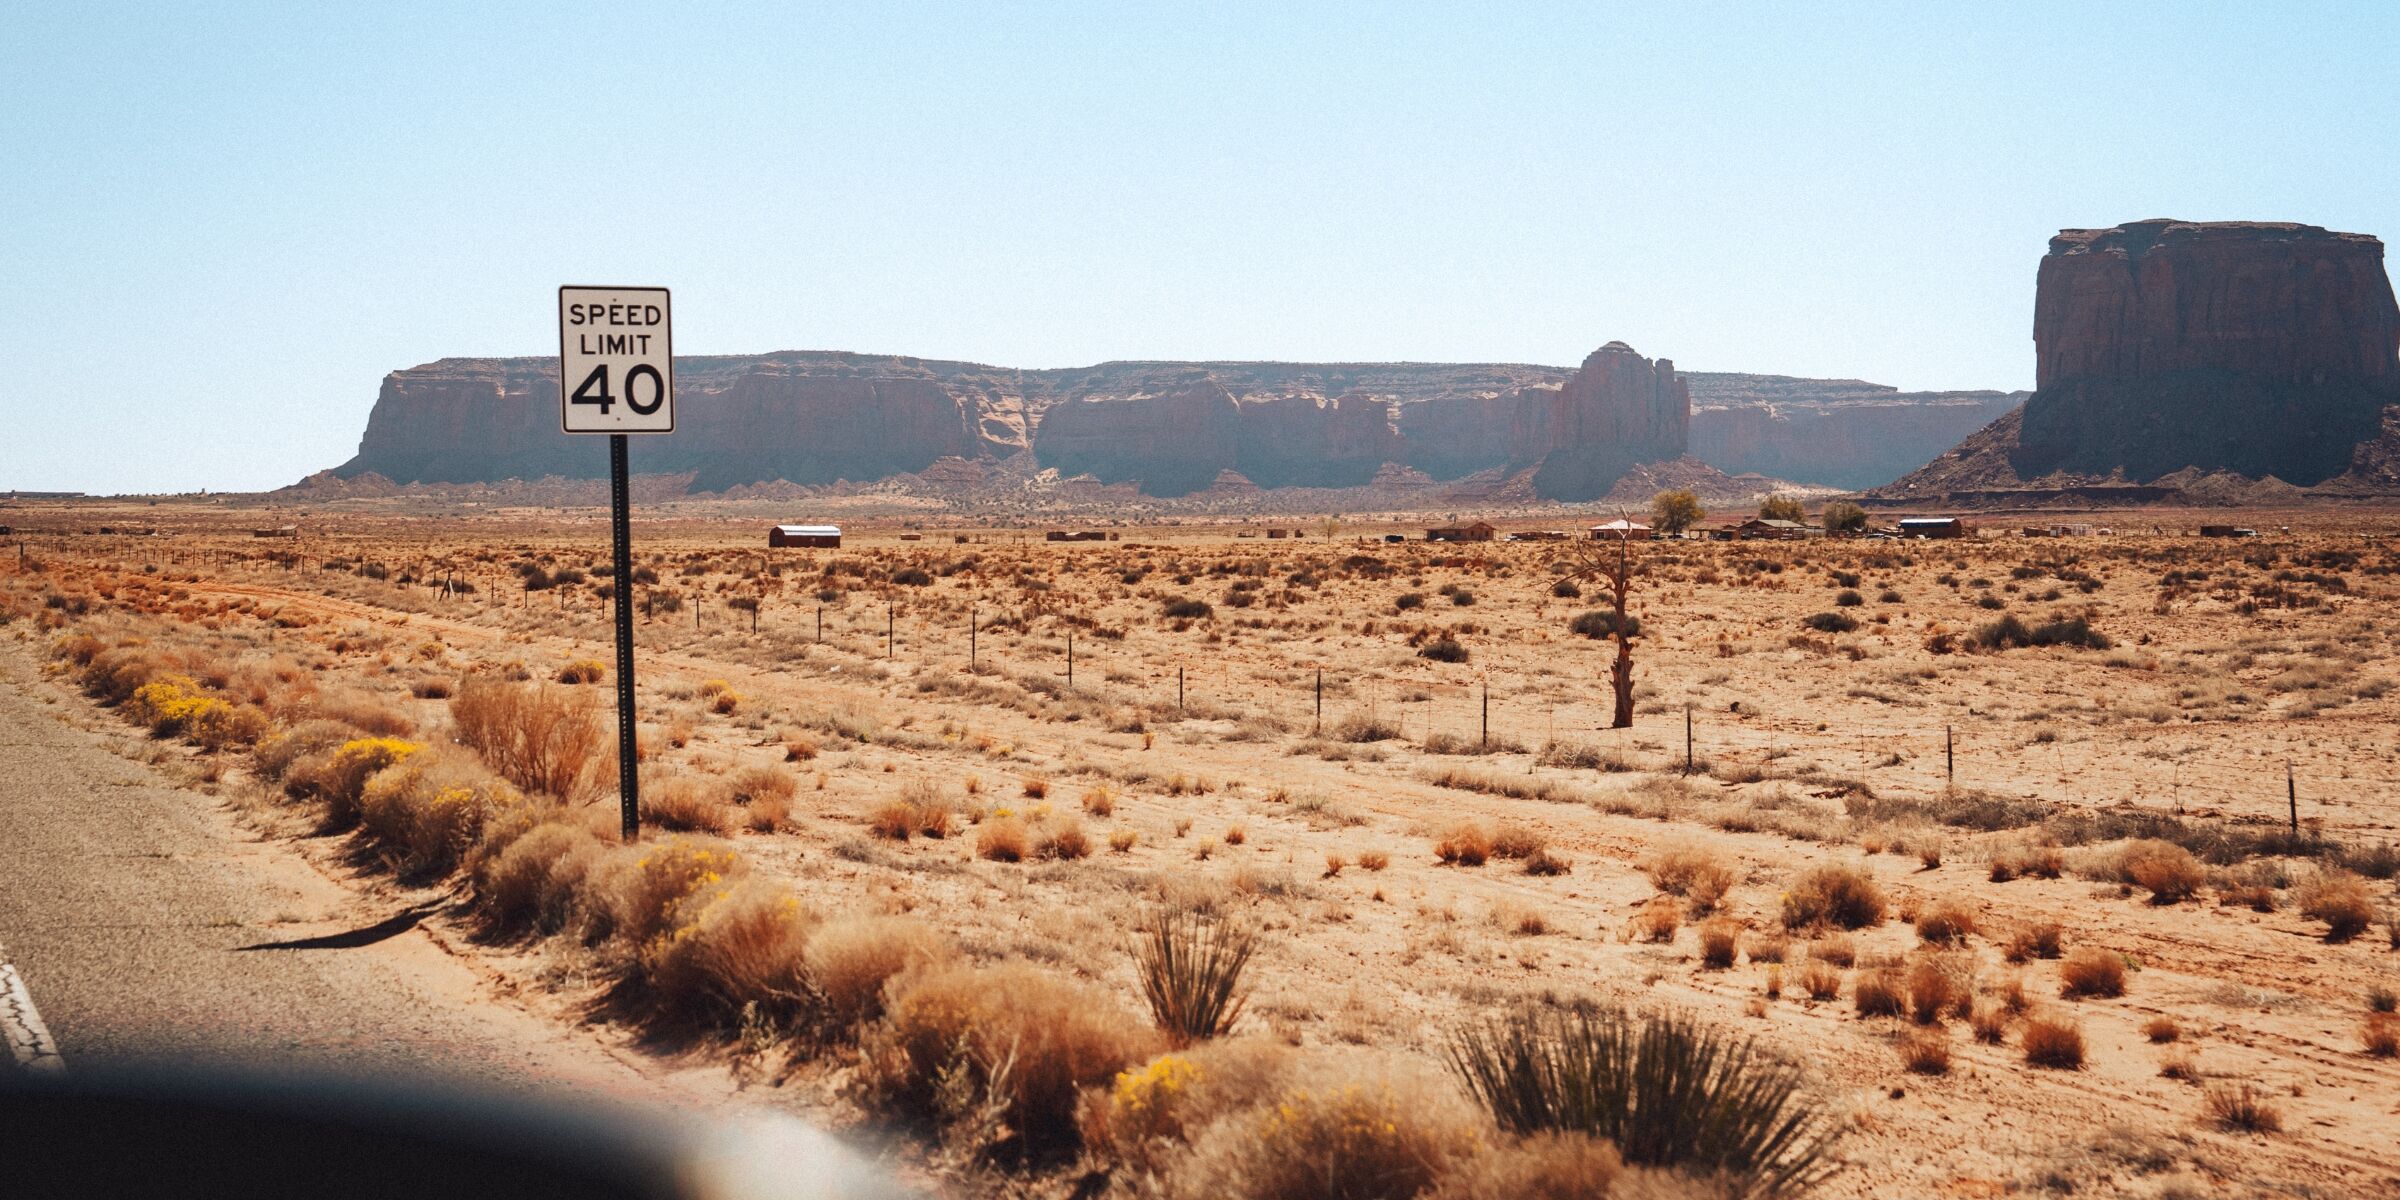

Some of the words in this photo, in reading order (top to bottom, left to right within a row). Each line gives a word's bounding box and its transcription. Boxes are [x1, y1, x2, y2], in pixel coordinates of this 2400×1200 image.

[570, 304, 661, 326] SPEED
[581, 334, 651, 355] LIMIT
[571, 363, 665, 415] 40
